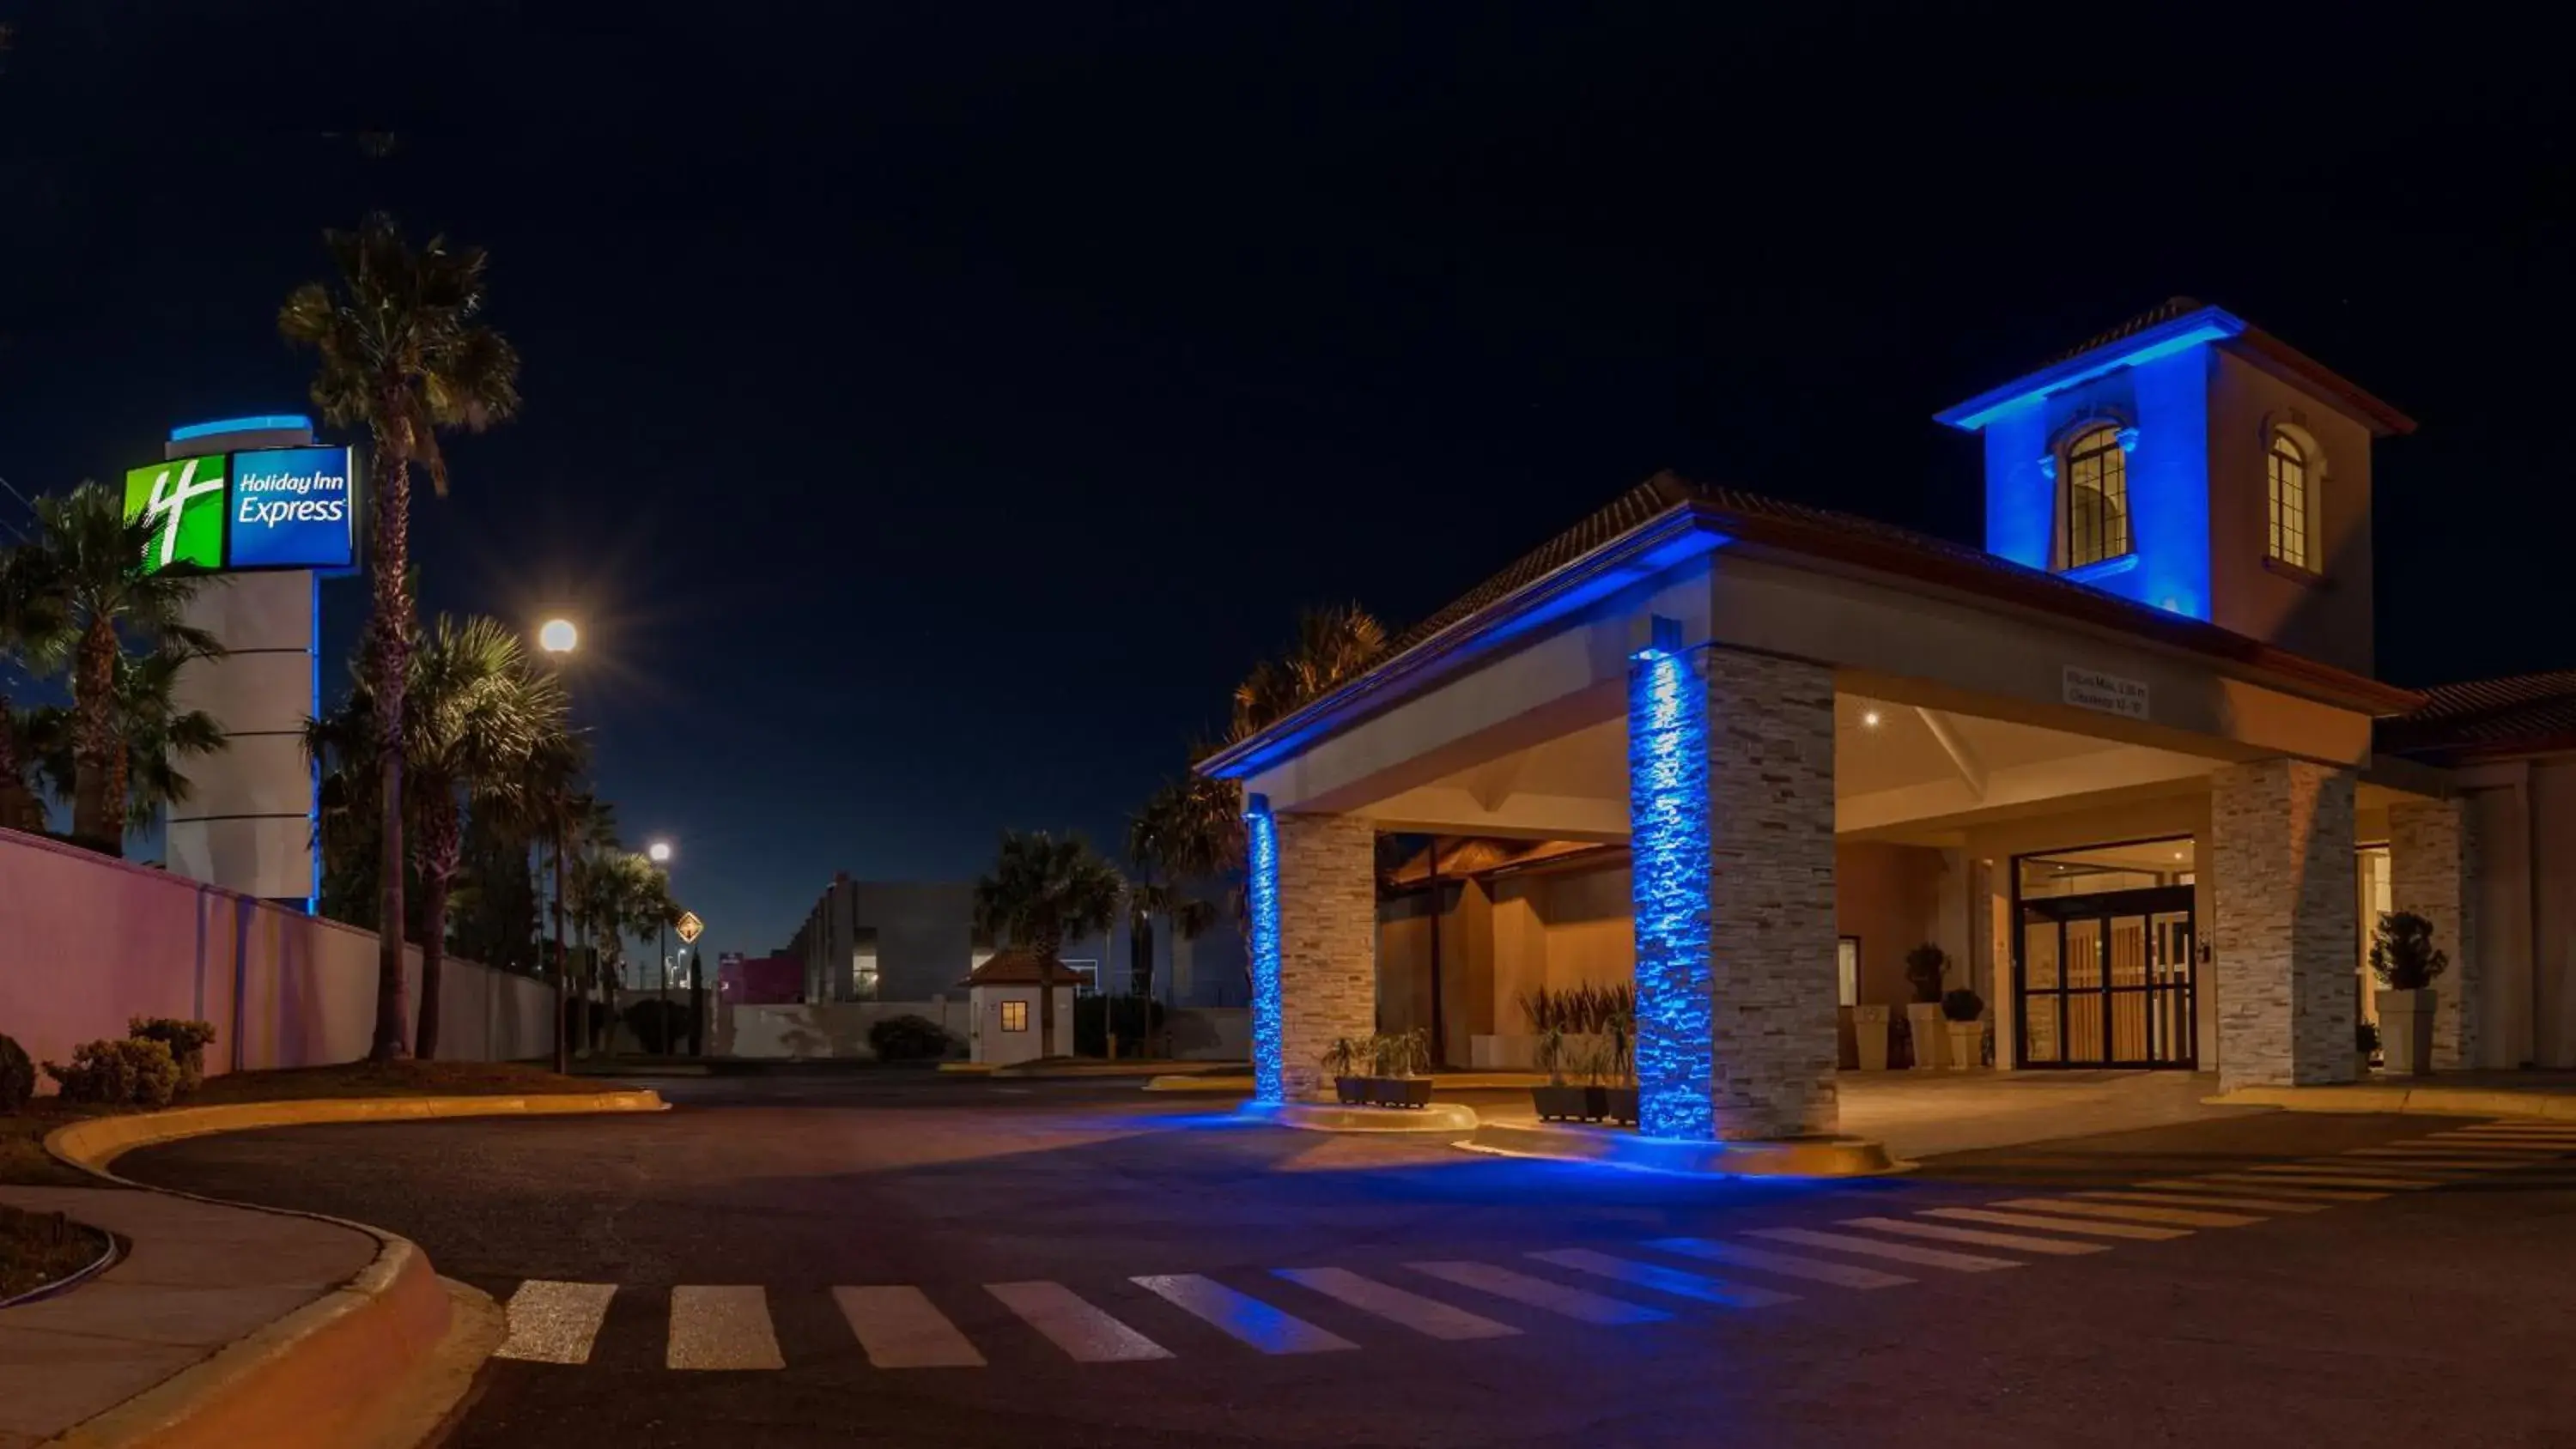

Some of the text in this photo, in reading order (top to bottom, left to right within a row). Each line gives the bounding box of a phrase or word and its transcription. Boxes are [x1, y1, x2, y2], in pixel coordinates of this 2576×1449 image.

[240, 470, 344, 494] Holiday Inn
[239, 496, 343, 529] Express
